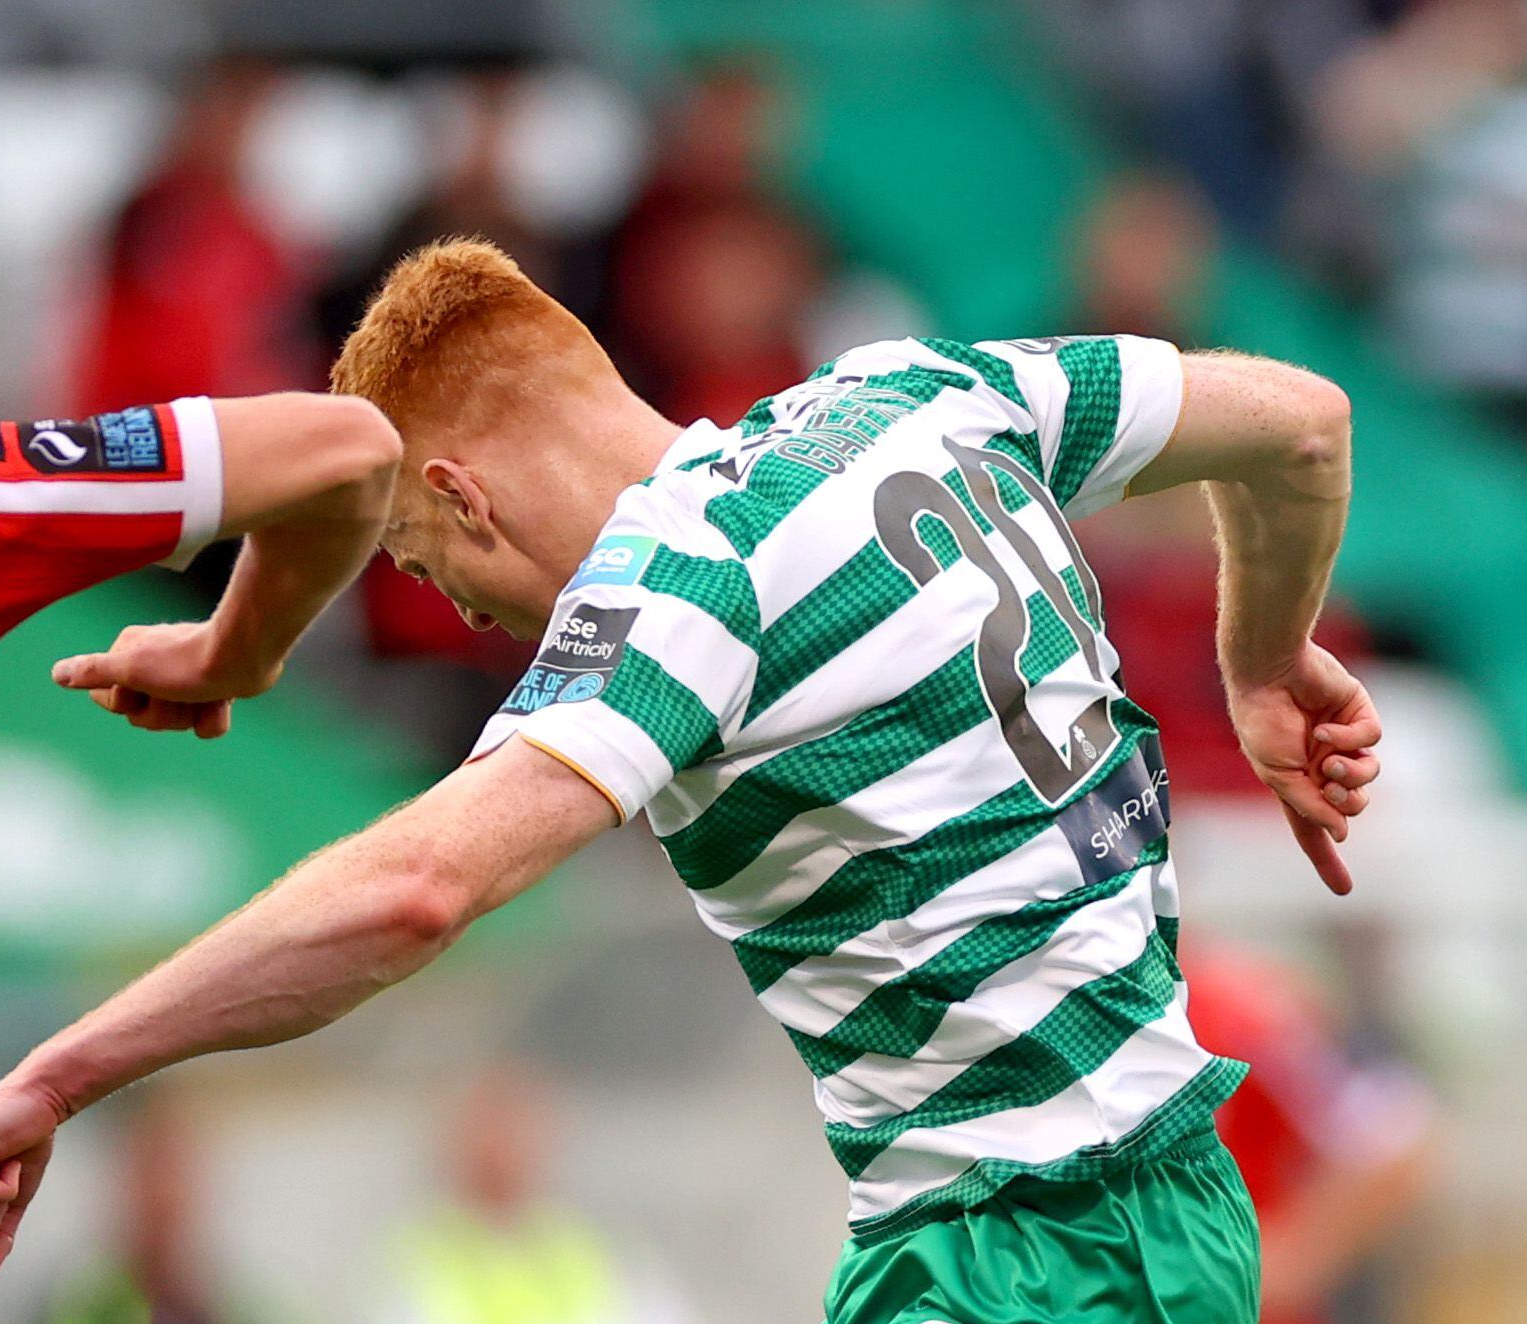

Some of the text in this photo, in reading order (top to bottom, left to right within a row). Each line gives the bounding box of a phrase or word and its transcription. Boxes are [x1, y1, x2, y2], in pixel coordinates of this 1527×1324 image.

[556, 617, 598, 640] sse
[549, 634, 617, 661] Airtricity
[544, 672, 566, 692] OF
